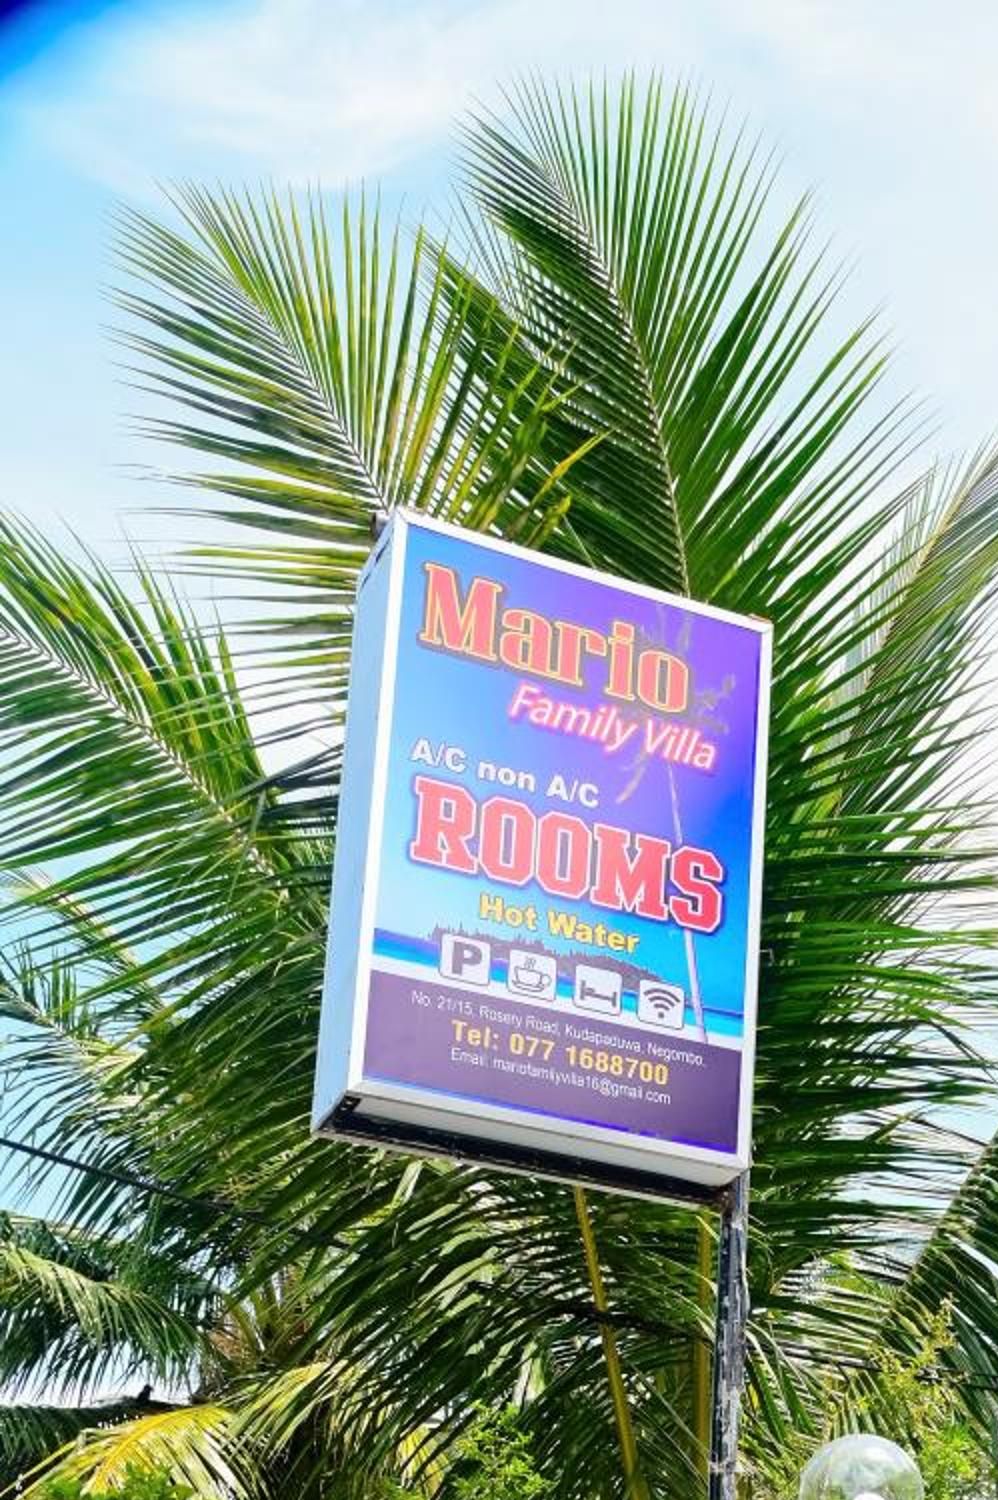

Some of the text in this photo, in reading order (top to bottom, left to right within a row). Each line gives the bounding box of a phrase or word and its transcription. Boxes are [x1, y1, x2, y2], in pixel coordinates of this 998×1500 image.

[418, 561, 689, 714] Mario
[510, 683, 717, 770] Family Villa
[411, 738, 600, 808] A/C non A/C
[410, 776, 724, 934] ROOMS
[479, 893, 641, 953] Hot Water
[451, 1018, 670, 1086] Tel: 077 1688700
[479, 1005, 522, 1029] Rosery
